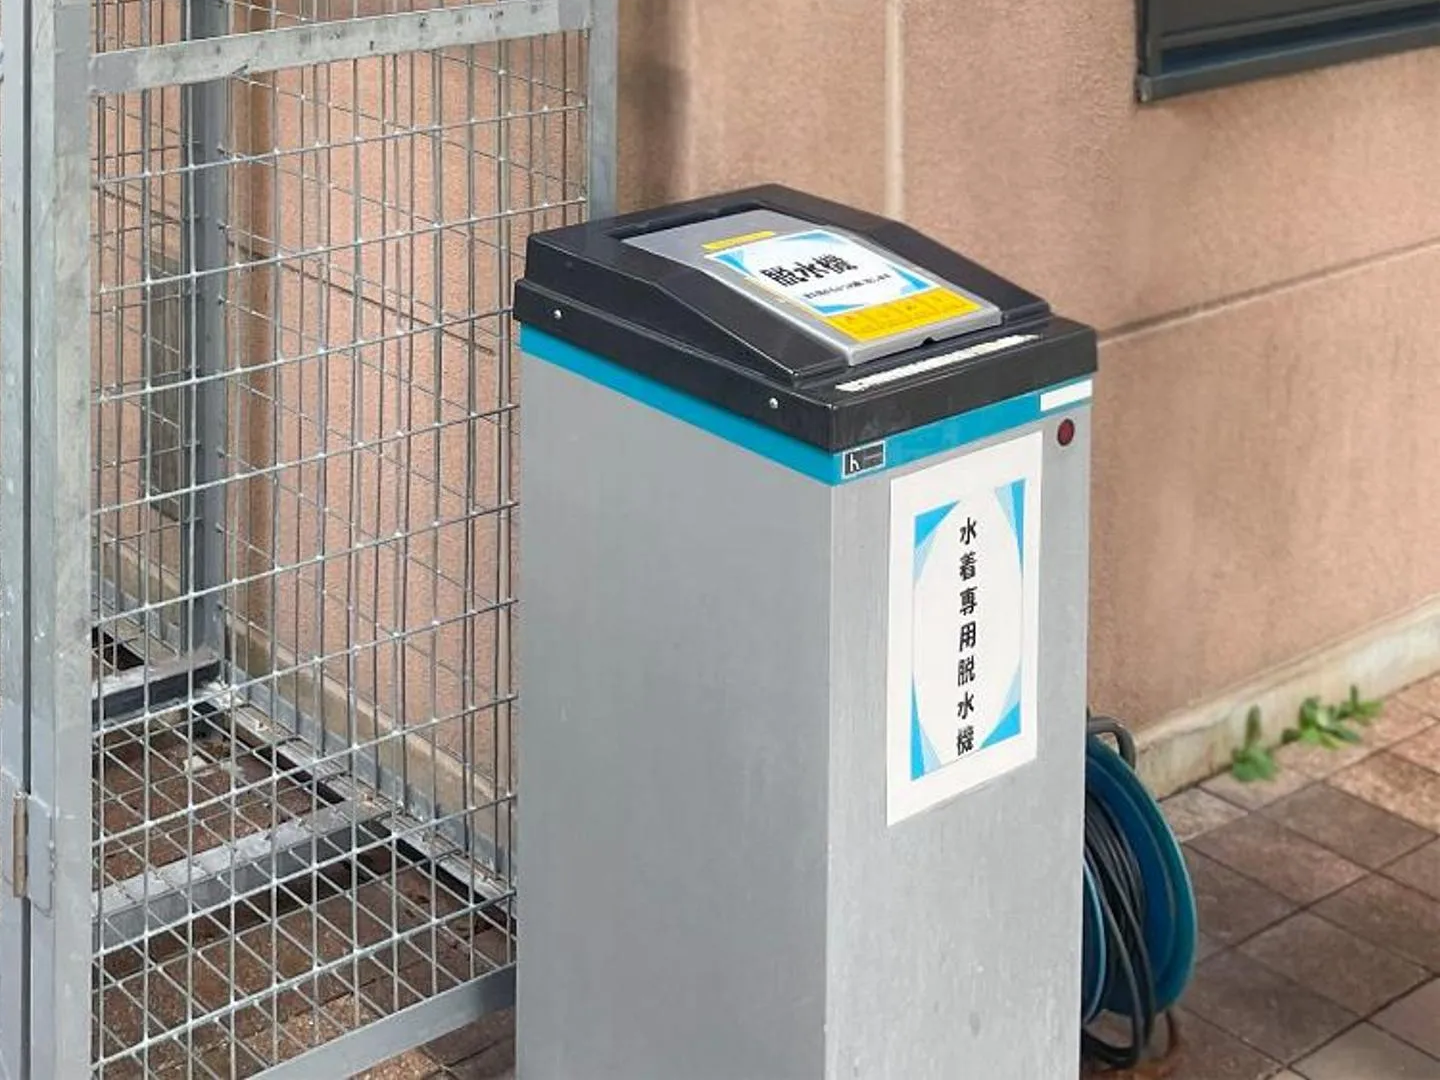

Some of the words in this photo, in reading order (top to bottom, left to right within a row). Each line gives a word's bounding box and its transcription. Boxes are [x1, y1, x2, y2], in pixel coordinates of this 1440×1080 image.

[956, 517, 977, 756] 水着専用脱水機
